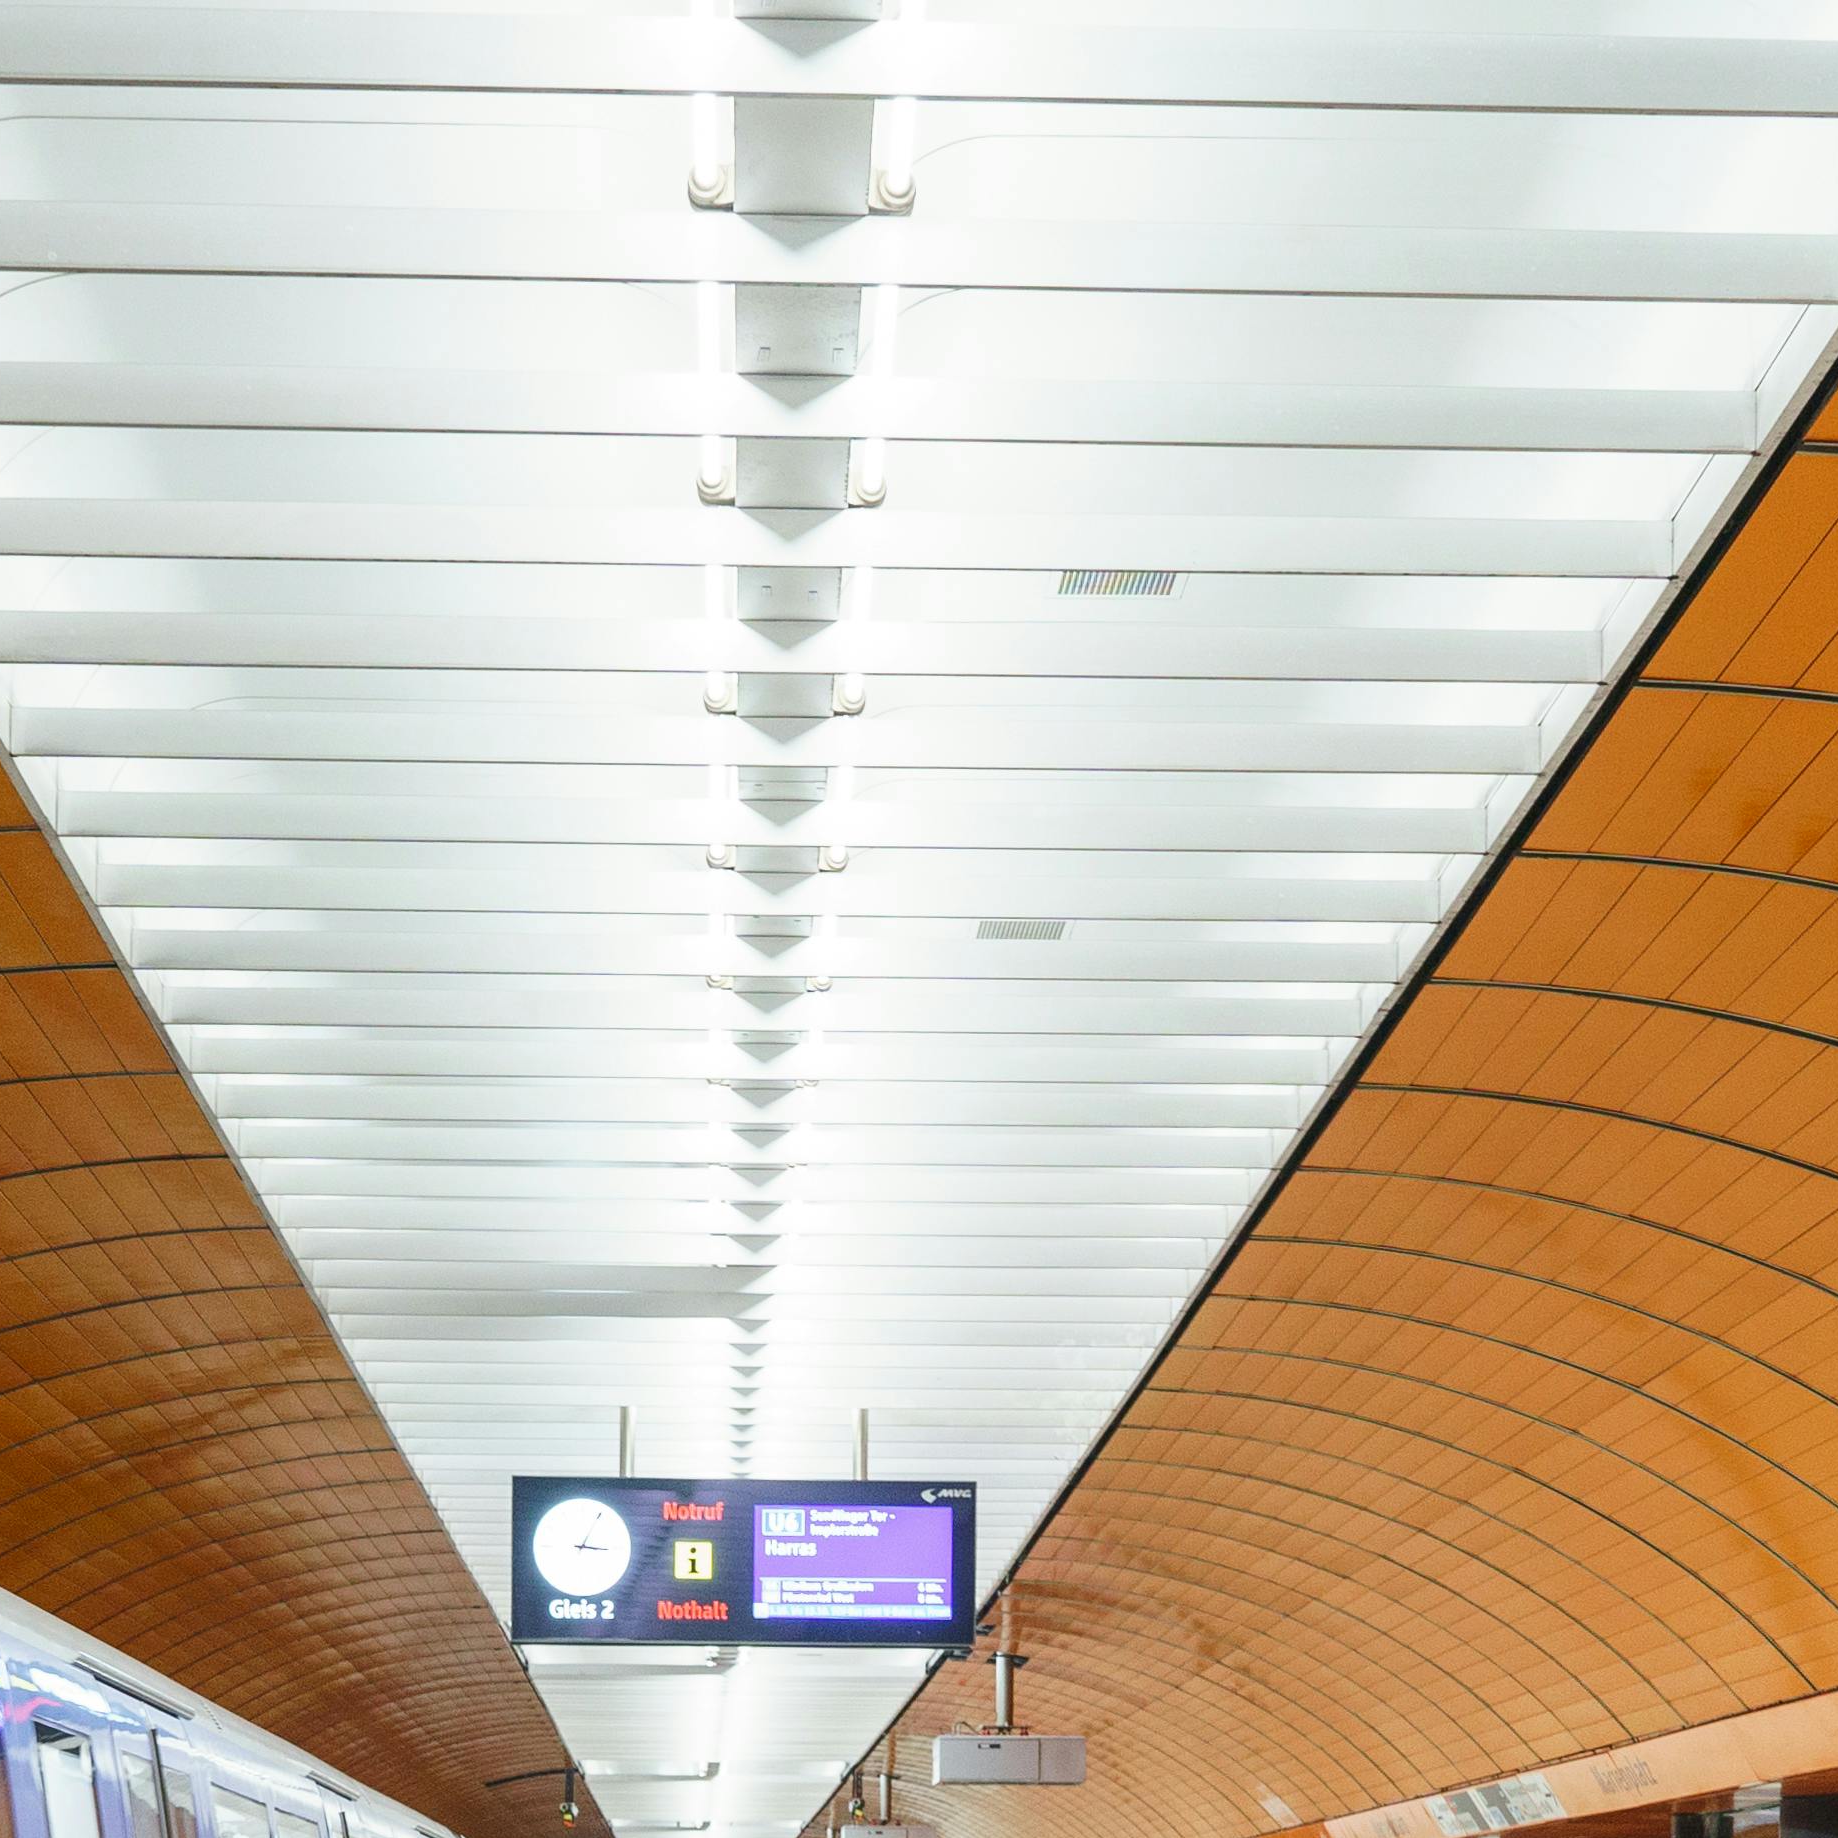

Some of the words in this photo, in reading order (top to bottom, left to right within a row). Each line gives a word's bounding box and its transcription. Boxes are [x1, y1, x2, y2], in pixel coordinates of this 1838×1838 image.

[663, 1501, 724, 1520] Notruf
[767, 1512, 800, 1532] U6
[765, 1539, 817, 1556] Harras
[548, 1599, 597, 1619] Gleis
[601, 1600, 615, 1619] 2
[657, 1600, 728, 1620] Nothalt
